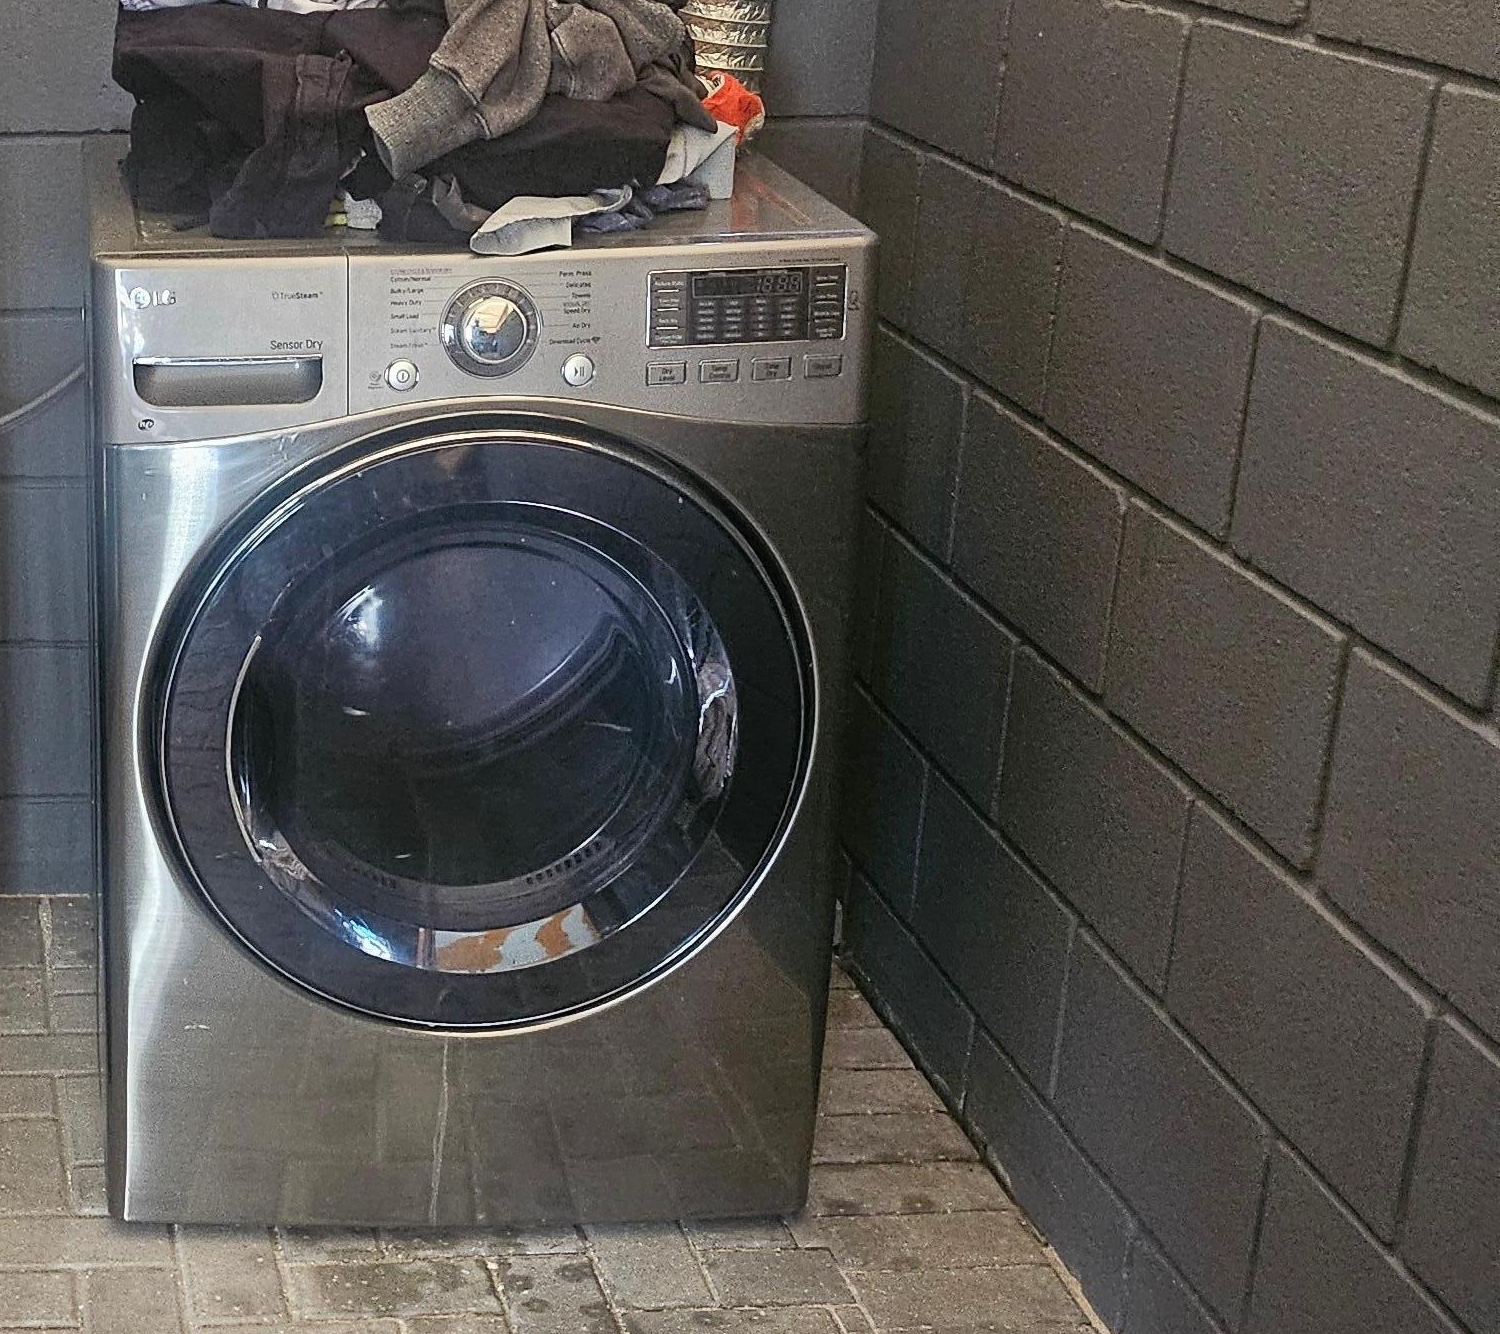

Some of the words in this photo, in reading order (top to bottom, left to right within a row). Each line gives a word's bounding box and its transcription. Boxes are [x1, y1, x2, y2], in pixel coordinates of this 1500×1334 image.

[152, 290, 177, 307] LG
[269, 340, 303, 350] Sensor
[305, 338, 323, 351] Dry
